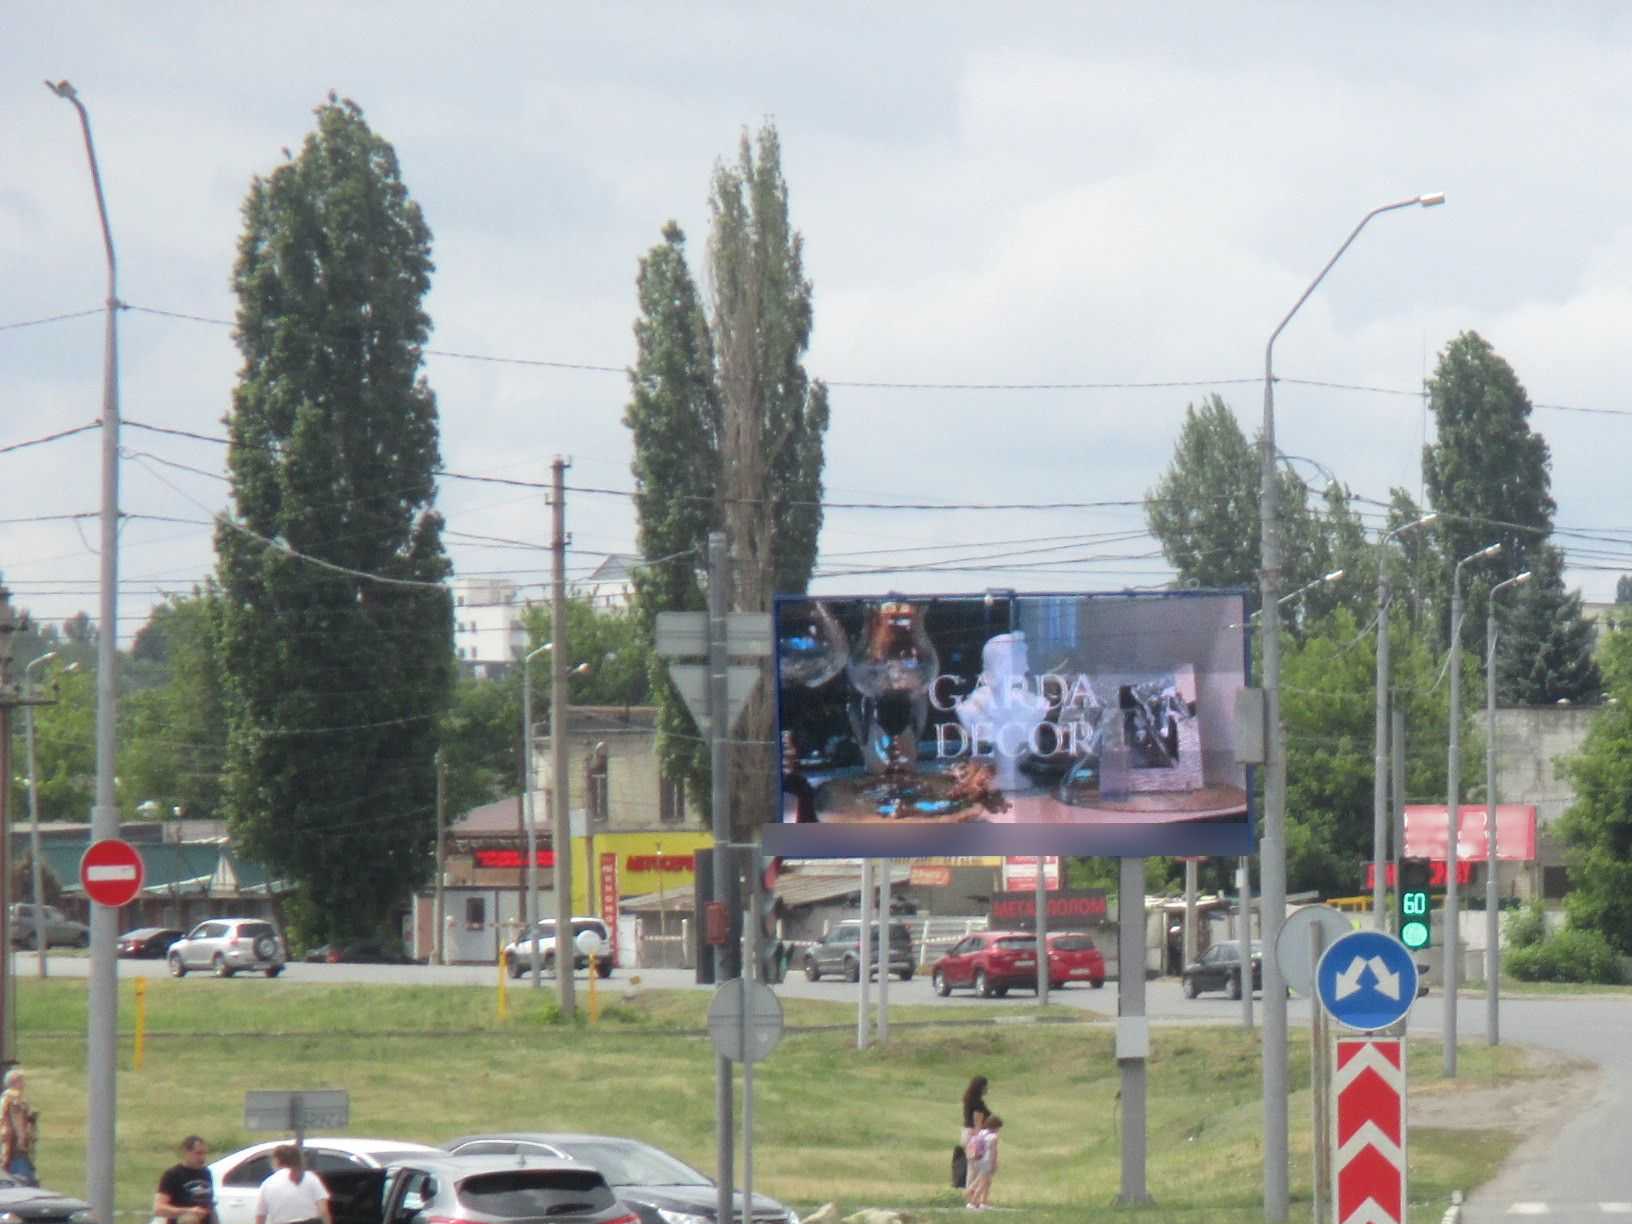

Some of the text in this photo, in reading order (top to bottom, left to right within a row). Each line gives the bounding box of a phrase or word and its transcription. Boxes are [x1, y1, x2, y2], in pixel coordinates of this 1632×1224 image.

[929, 673, 1099, 711] GARDA
[934, 721, 1098, 758] DECOR
[1403, 893, 1426, 914] 60
